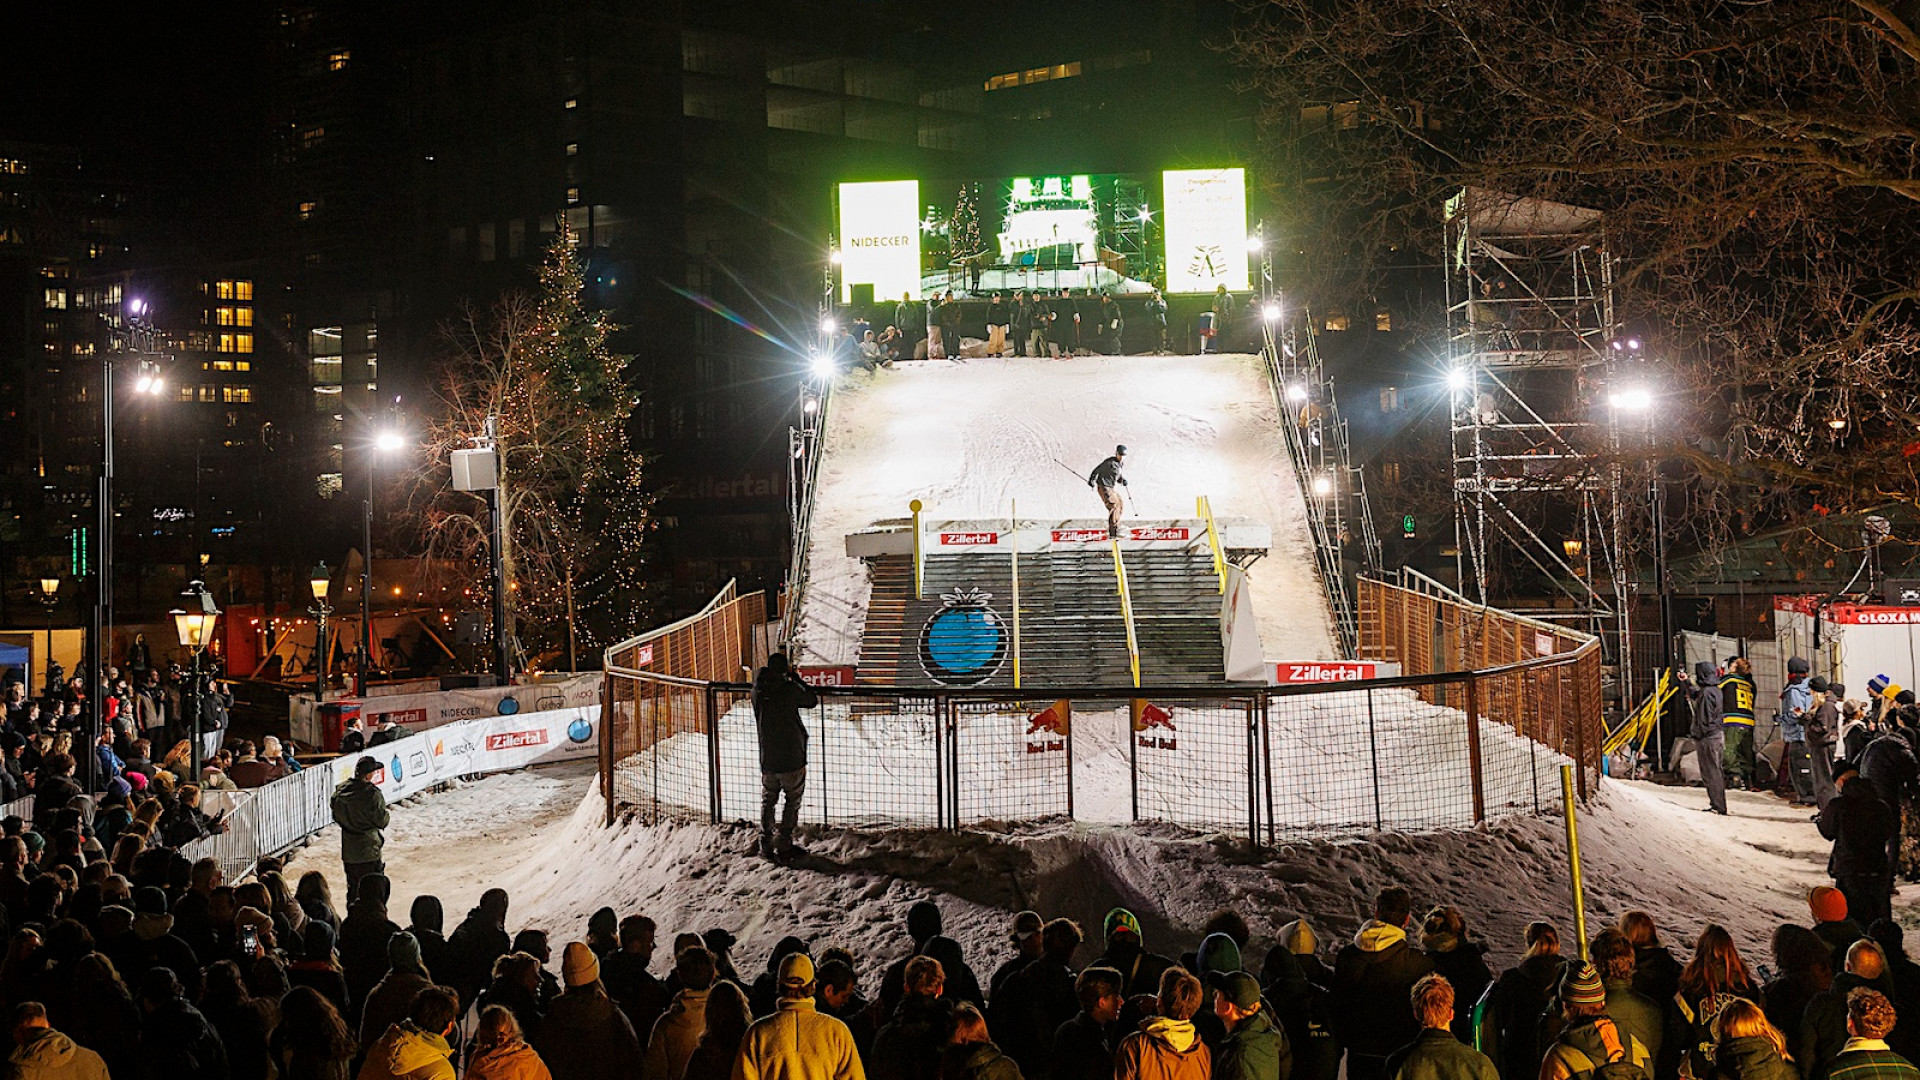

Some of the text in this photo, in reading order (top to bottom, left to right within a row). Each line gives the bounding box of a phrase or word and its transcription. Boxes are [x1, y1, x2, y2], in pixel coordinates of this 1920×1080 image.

[851, 235, 909, 247] NIDECKER
[947, 534, 991, 544] Zillertal
[1139, 529, 1182, 540] Zillertal
[1289, 665, 1363, 680] Zillertal
[441, 707, 480, 718] NIDECKER
[492, 731, 541, 749] Zillertal
[1138, 737, 1176, 750] Red Bull
[1027, 740, 1064, 753] Red Bull
